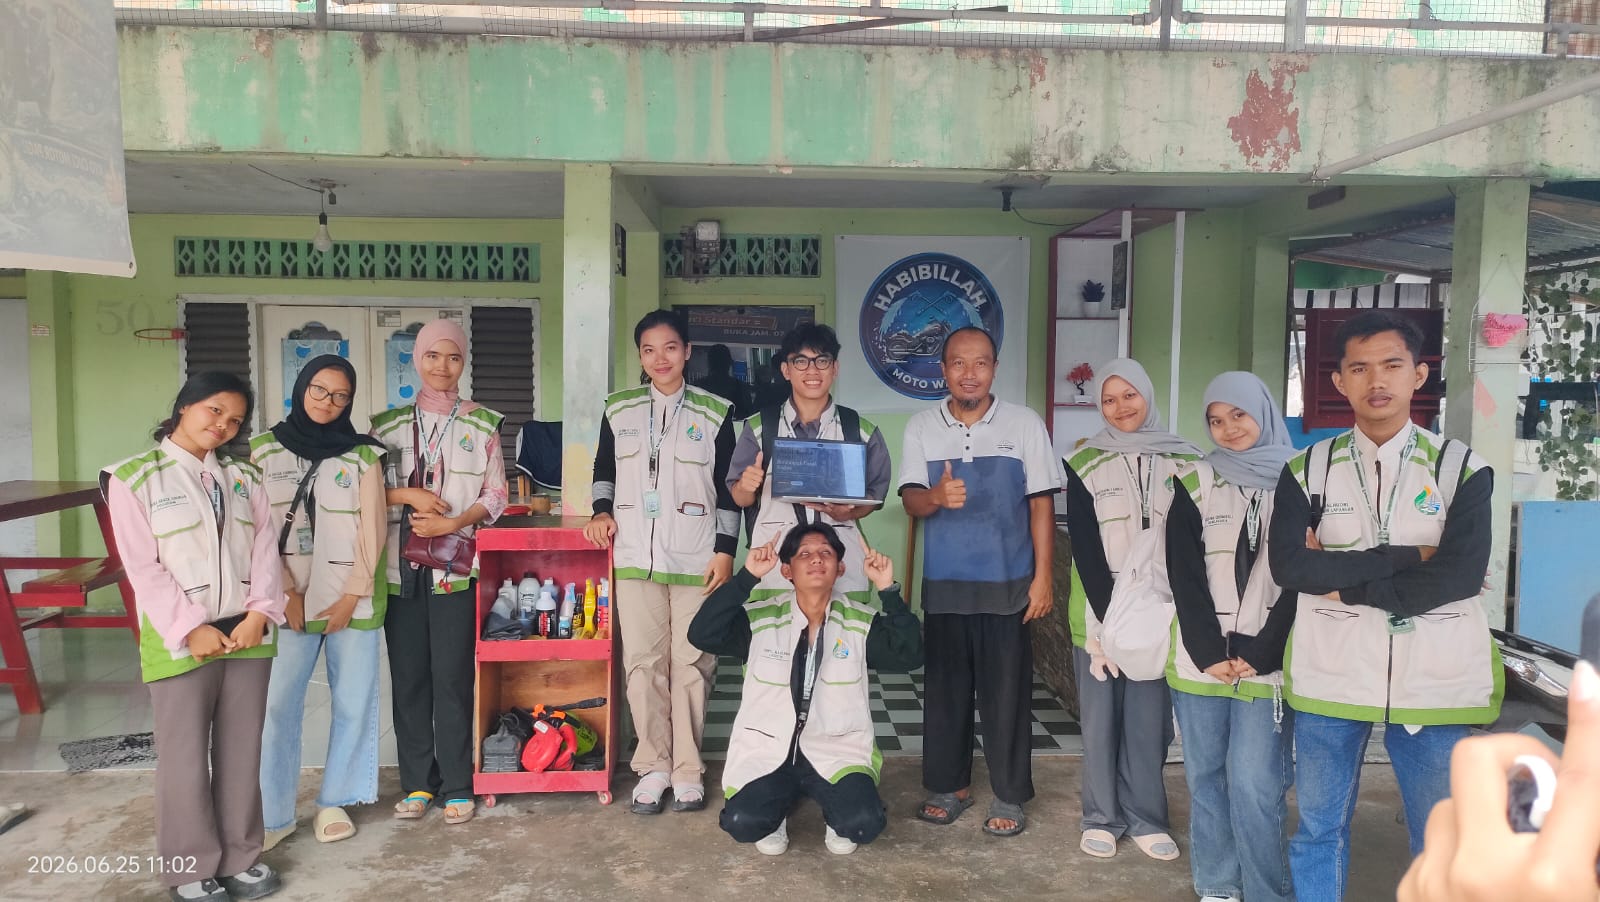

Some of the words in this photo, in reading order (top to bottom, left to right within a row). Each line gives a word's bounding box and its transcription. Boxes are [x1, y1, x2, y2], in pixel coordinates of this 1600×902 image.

[873, 263, 988, 312] HABIBILLAH
[723, 328, 748, 336] BUKA
[892, 368, 928, 389] MOTO
